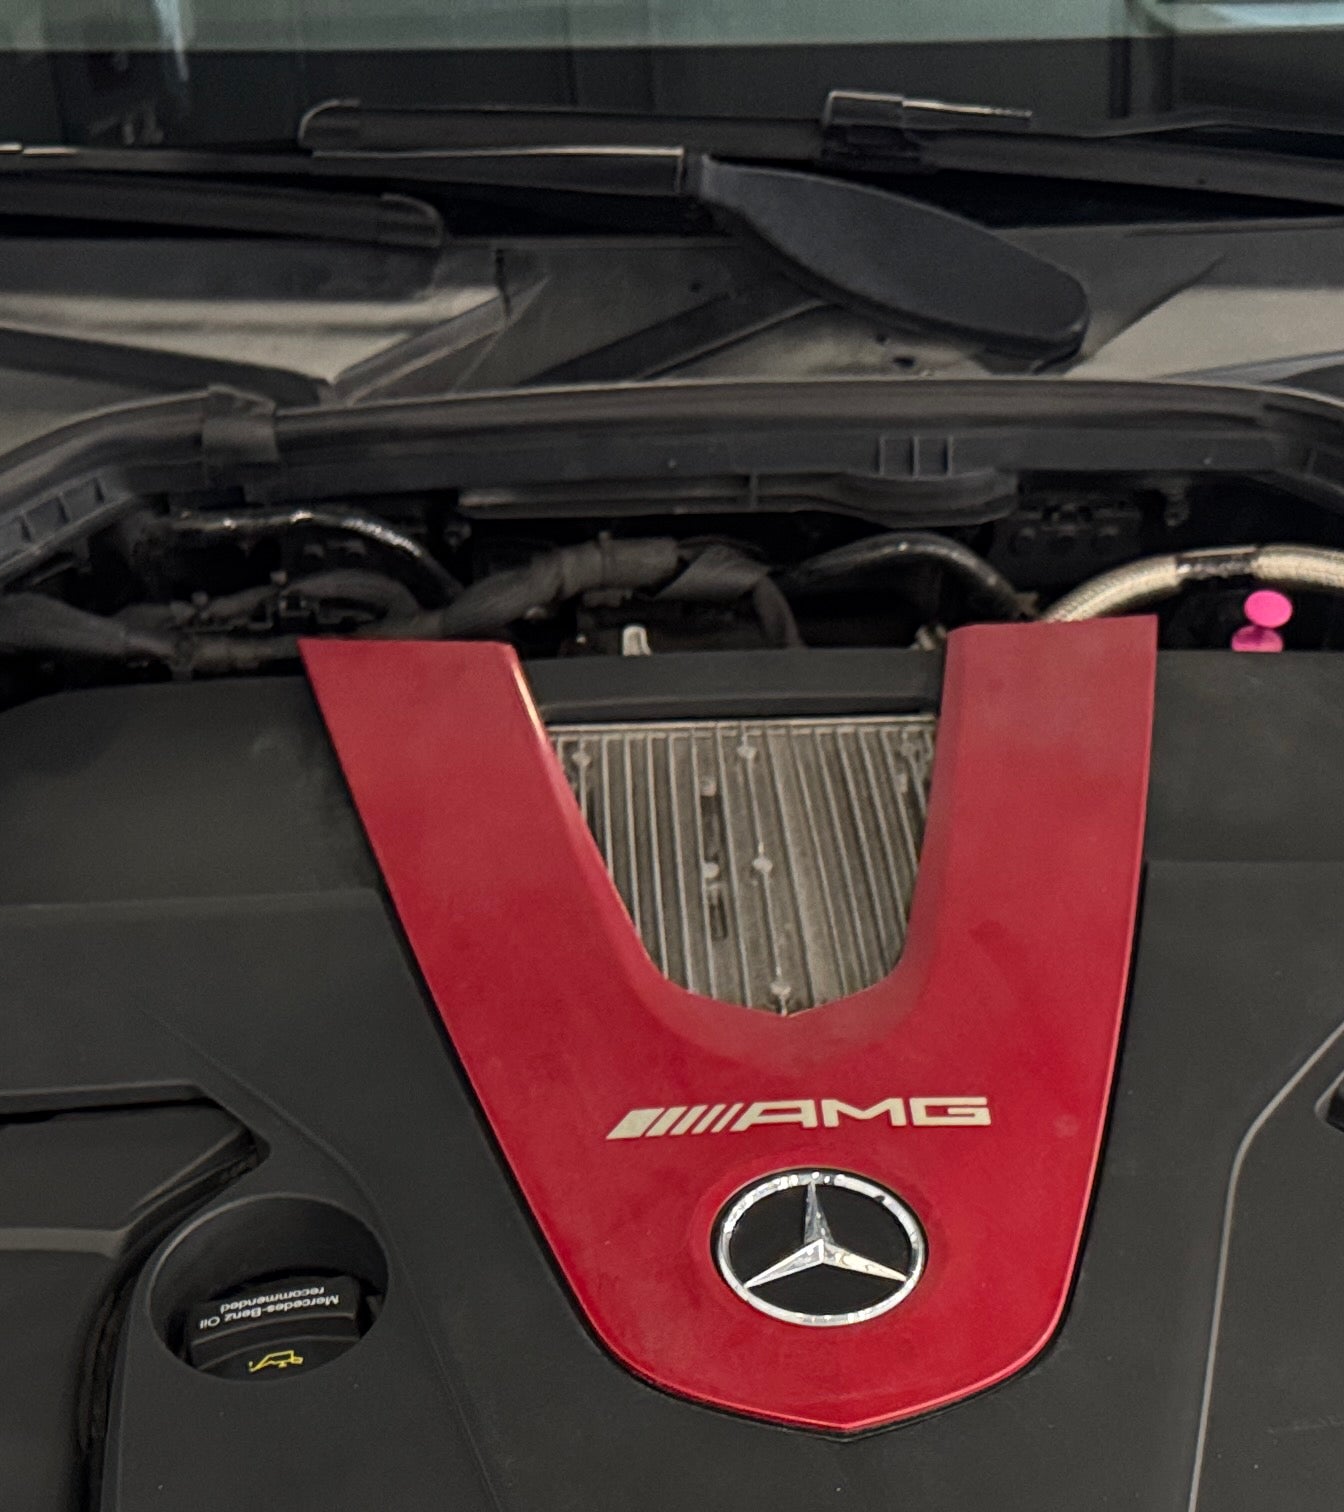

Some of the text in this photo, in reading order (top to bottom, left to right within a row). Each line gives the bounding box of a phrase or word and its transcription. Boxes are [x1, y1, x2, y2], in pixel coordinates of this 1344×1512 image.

[730, 1096, 992, 1133] AMG
[199, 1294, 340, 1330] Mercedes-Benz Oil
[220, 1286, 325, 1315] recommended
